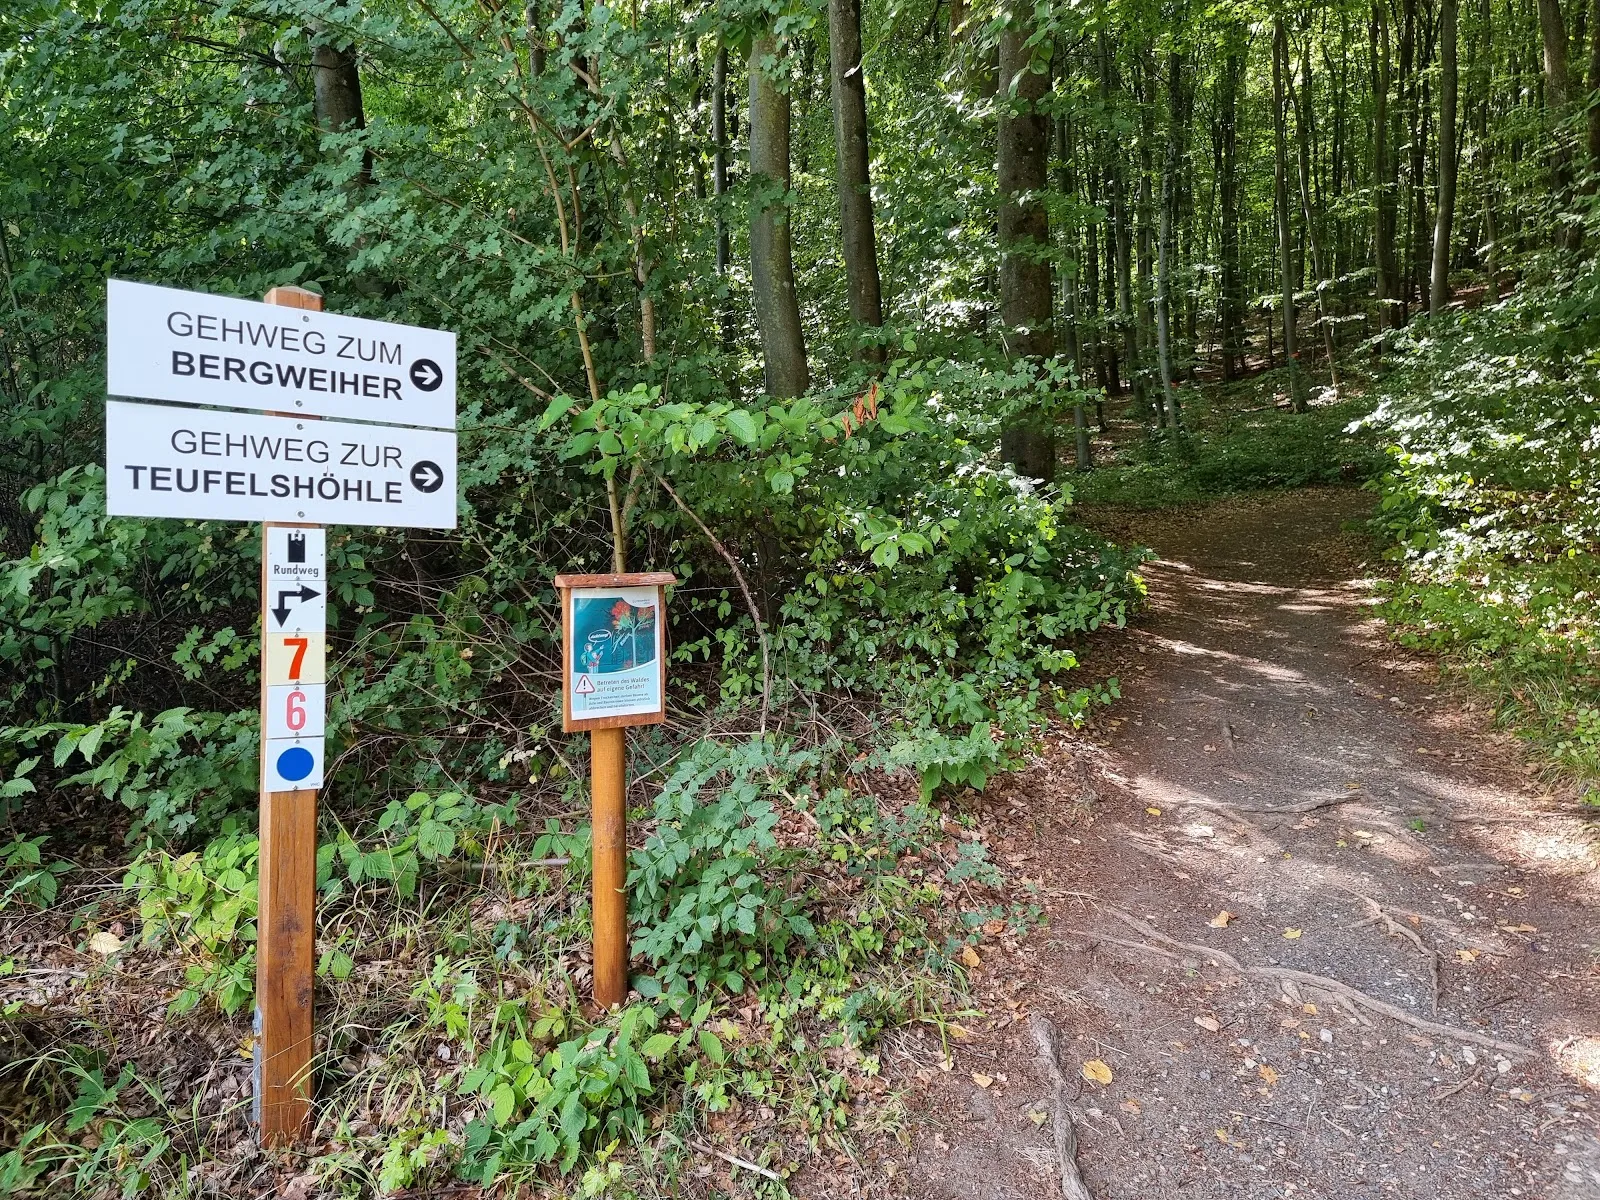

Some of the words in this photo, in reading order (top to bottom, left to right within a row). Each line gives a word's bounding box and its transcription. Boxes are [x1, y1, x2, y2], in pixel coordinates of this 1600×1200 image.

[167, 311, 326, 355] GEHWEG
[336, 335, 402, 365] ZUM
[172, 351, 403, 400] BERGWEIHER
[171, 429, 329, 463] GEHWEG
[340, 443, 403, 469] ZUR
[124, 464, 403, 503] TEUFELSHÖHLE
[274, 564, 319, 577] Rundweg
[283, 638, 308, 680] 7
[286, 691, 306, 731] 6
